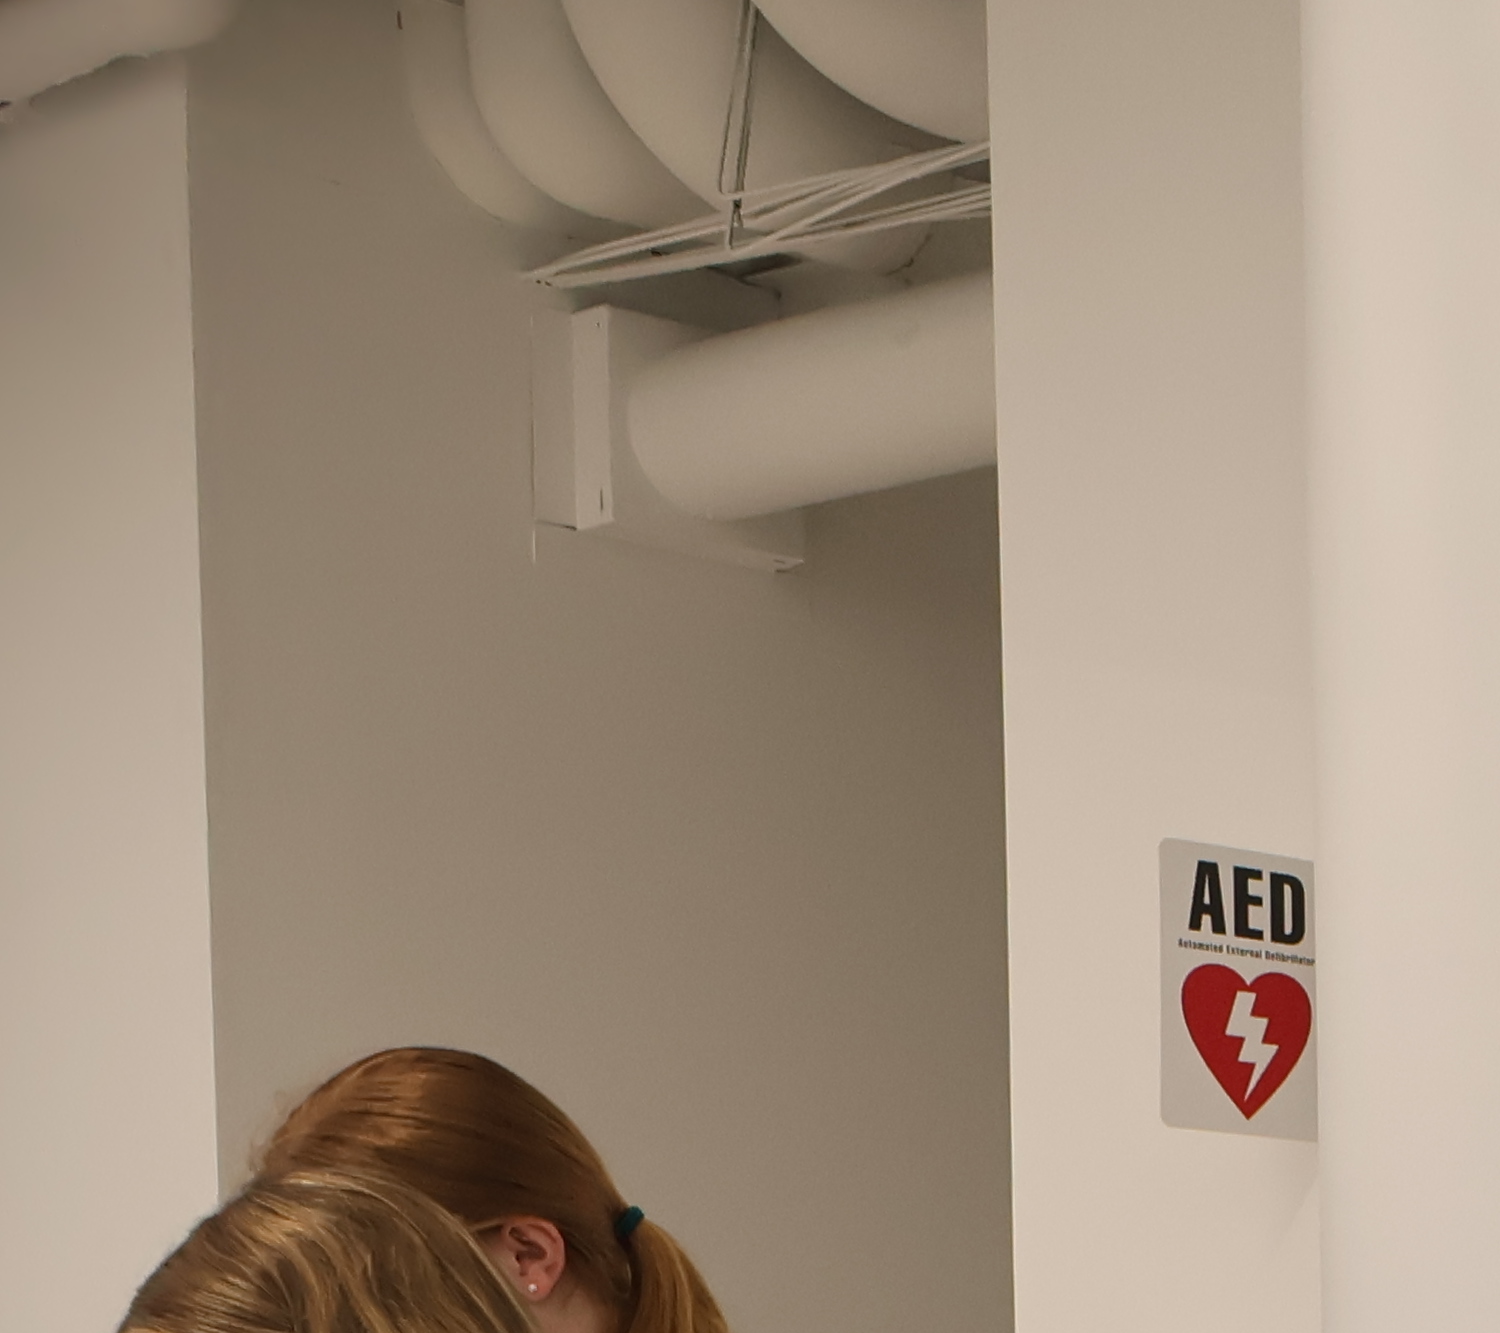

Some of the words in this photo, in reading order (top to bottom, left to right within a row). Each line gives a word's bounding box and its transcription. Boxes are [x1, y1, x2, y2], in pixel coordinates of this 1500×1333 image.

[1188, 860, 1306, 946] AED
[1177, 938, 1224, 954] Automated
[1226, 945, 1262, 960] External
[1264, 951, 1315, 967] Defibrillator
